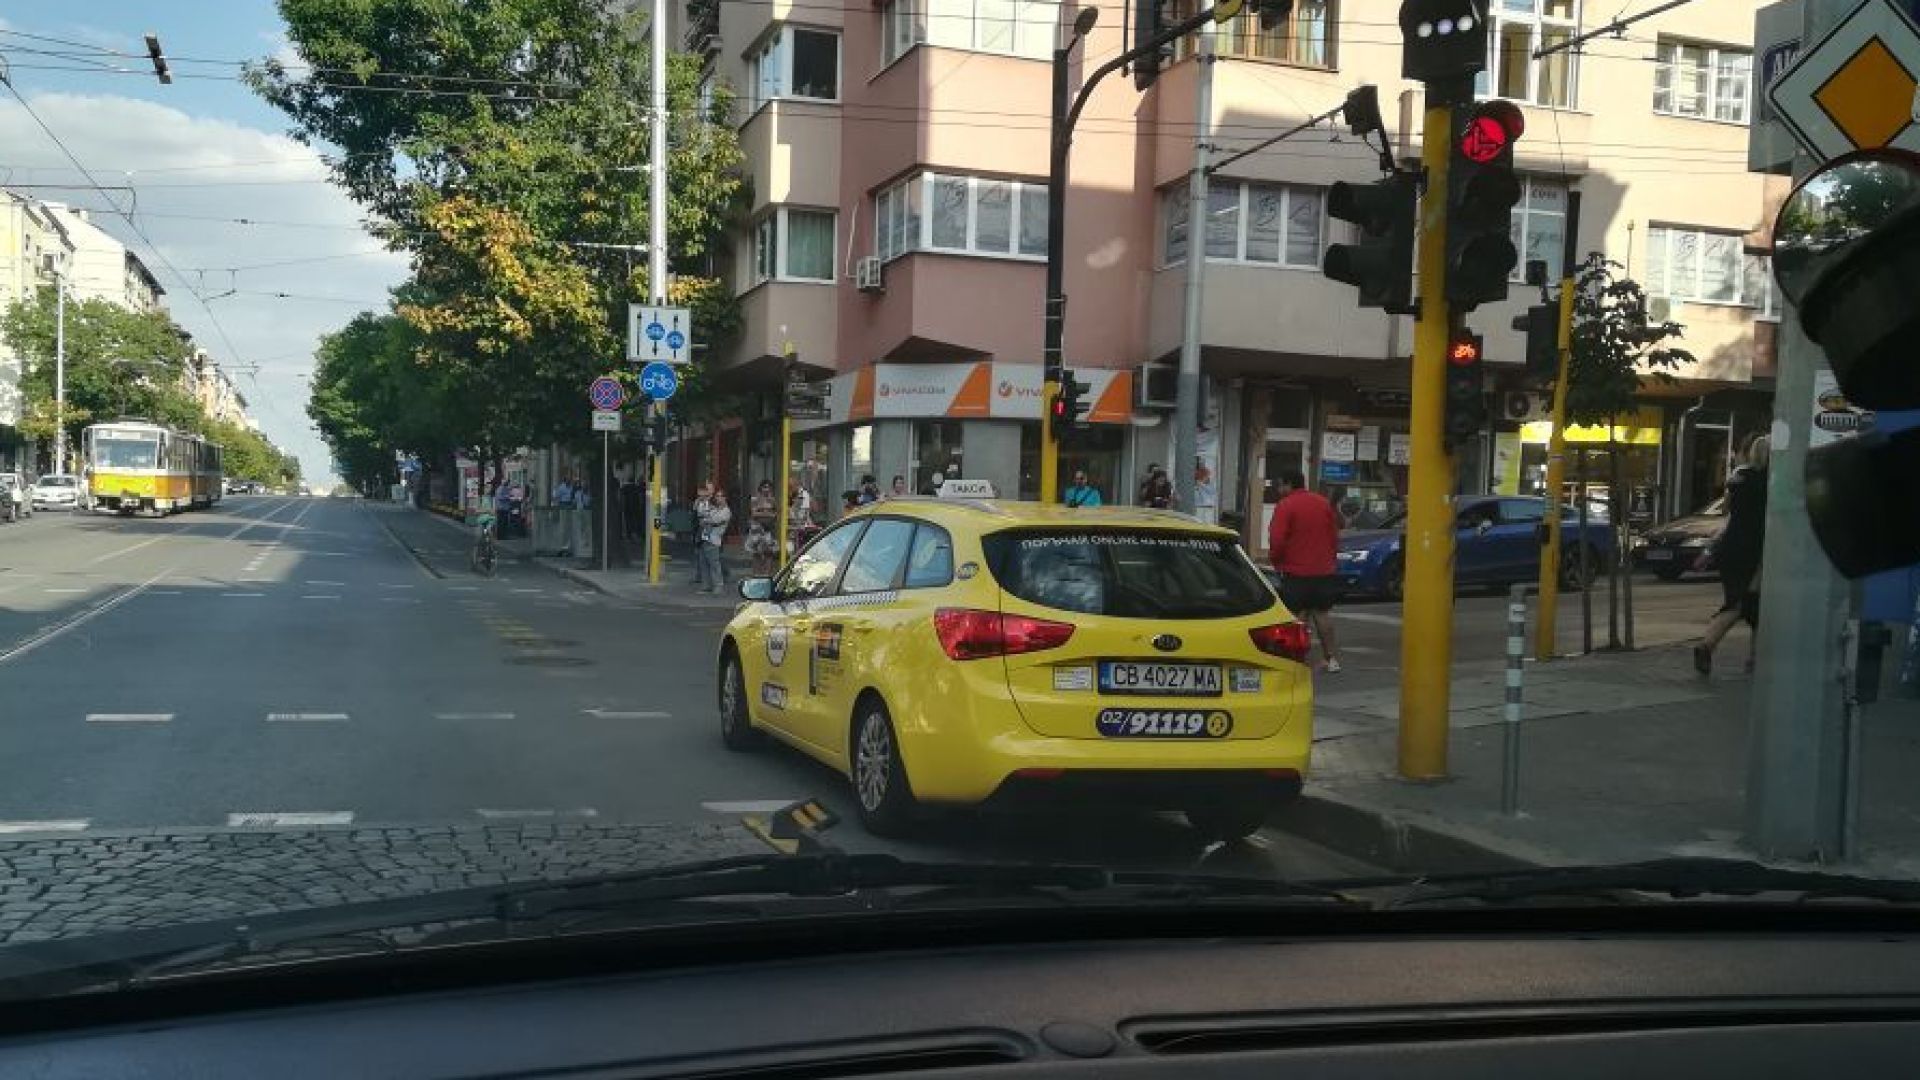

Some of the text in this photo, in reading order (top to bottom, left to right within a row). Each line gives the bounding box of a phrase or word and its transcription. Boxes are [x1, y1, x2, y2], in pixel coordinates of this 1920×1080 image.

[1114, 664, 1139, 685] CB
[1144, 665, 1189, 687] 4027
[1193, 667, 1217, 689] MA
